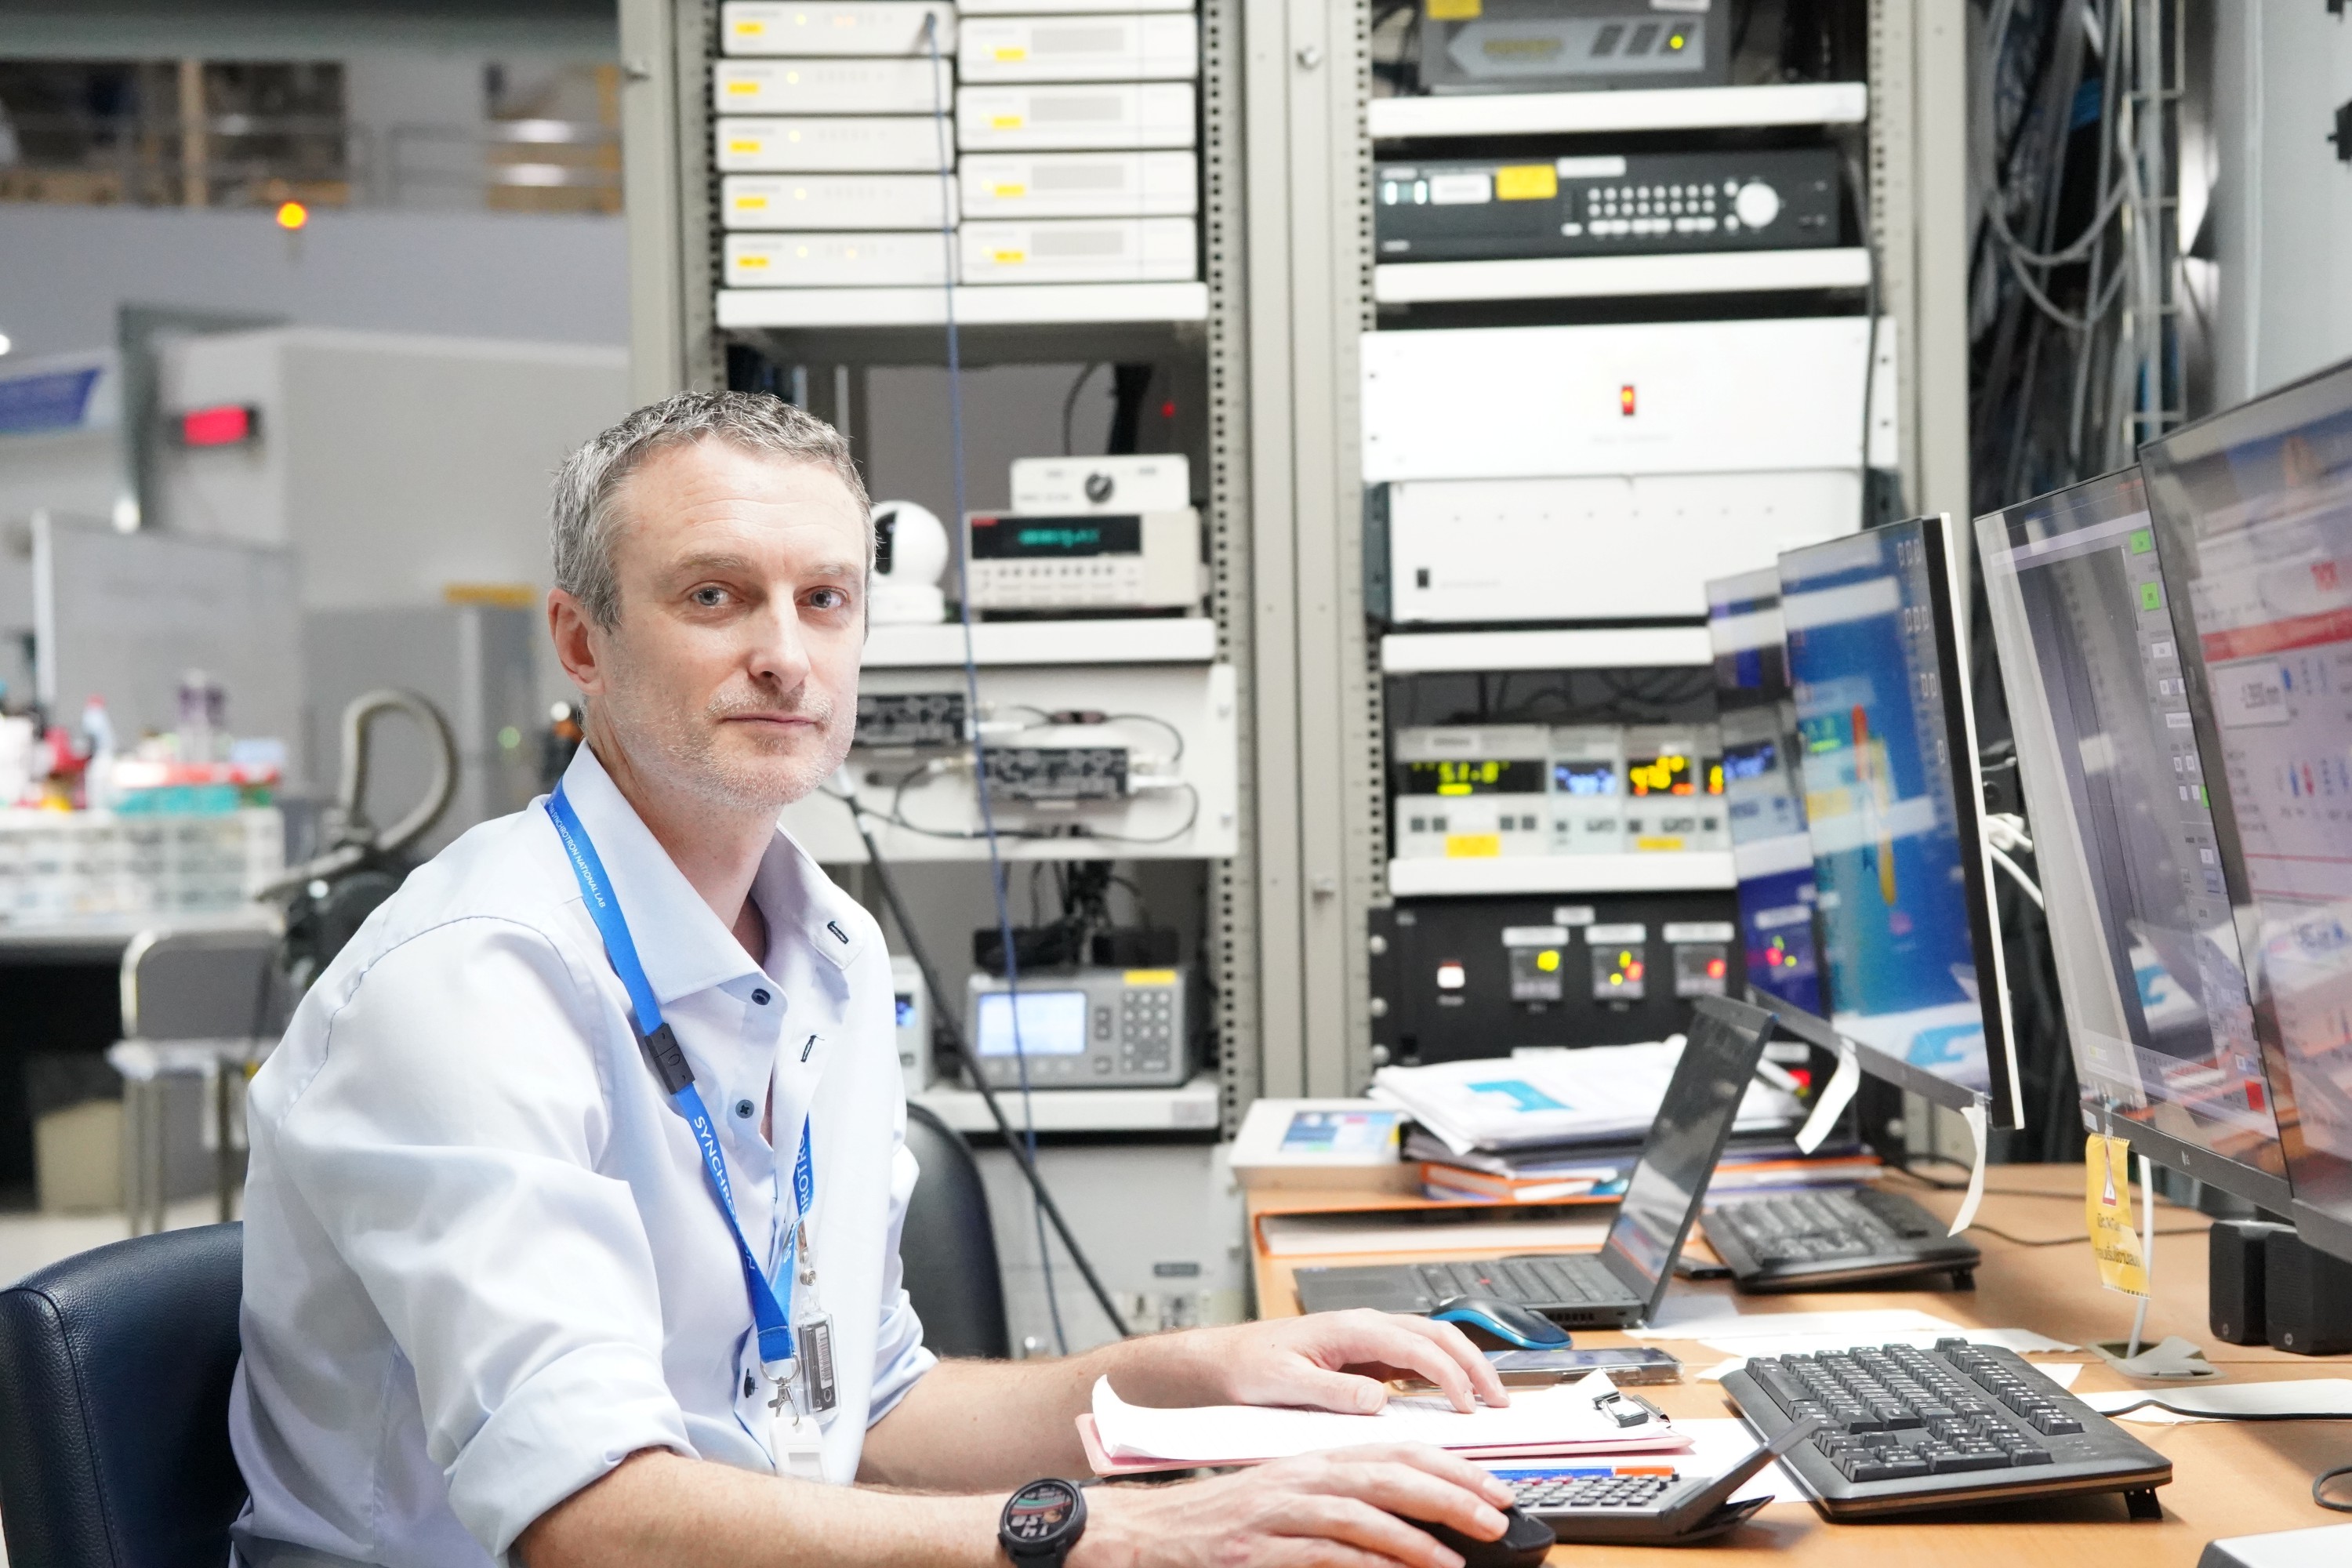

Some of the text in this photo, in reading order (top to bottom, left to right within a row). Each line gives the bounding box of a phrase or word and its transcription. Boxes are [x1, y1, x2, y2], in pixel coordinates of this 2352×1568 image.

[551, 811, 580, 856] SYNCHROTRON
[575, 853, 598, 894] NATIONAL
[594, 892, 606, 909] LAB
